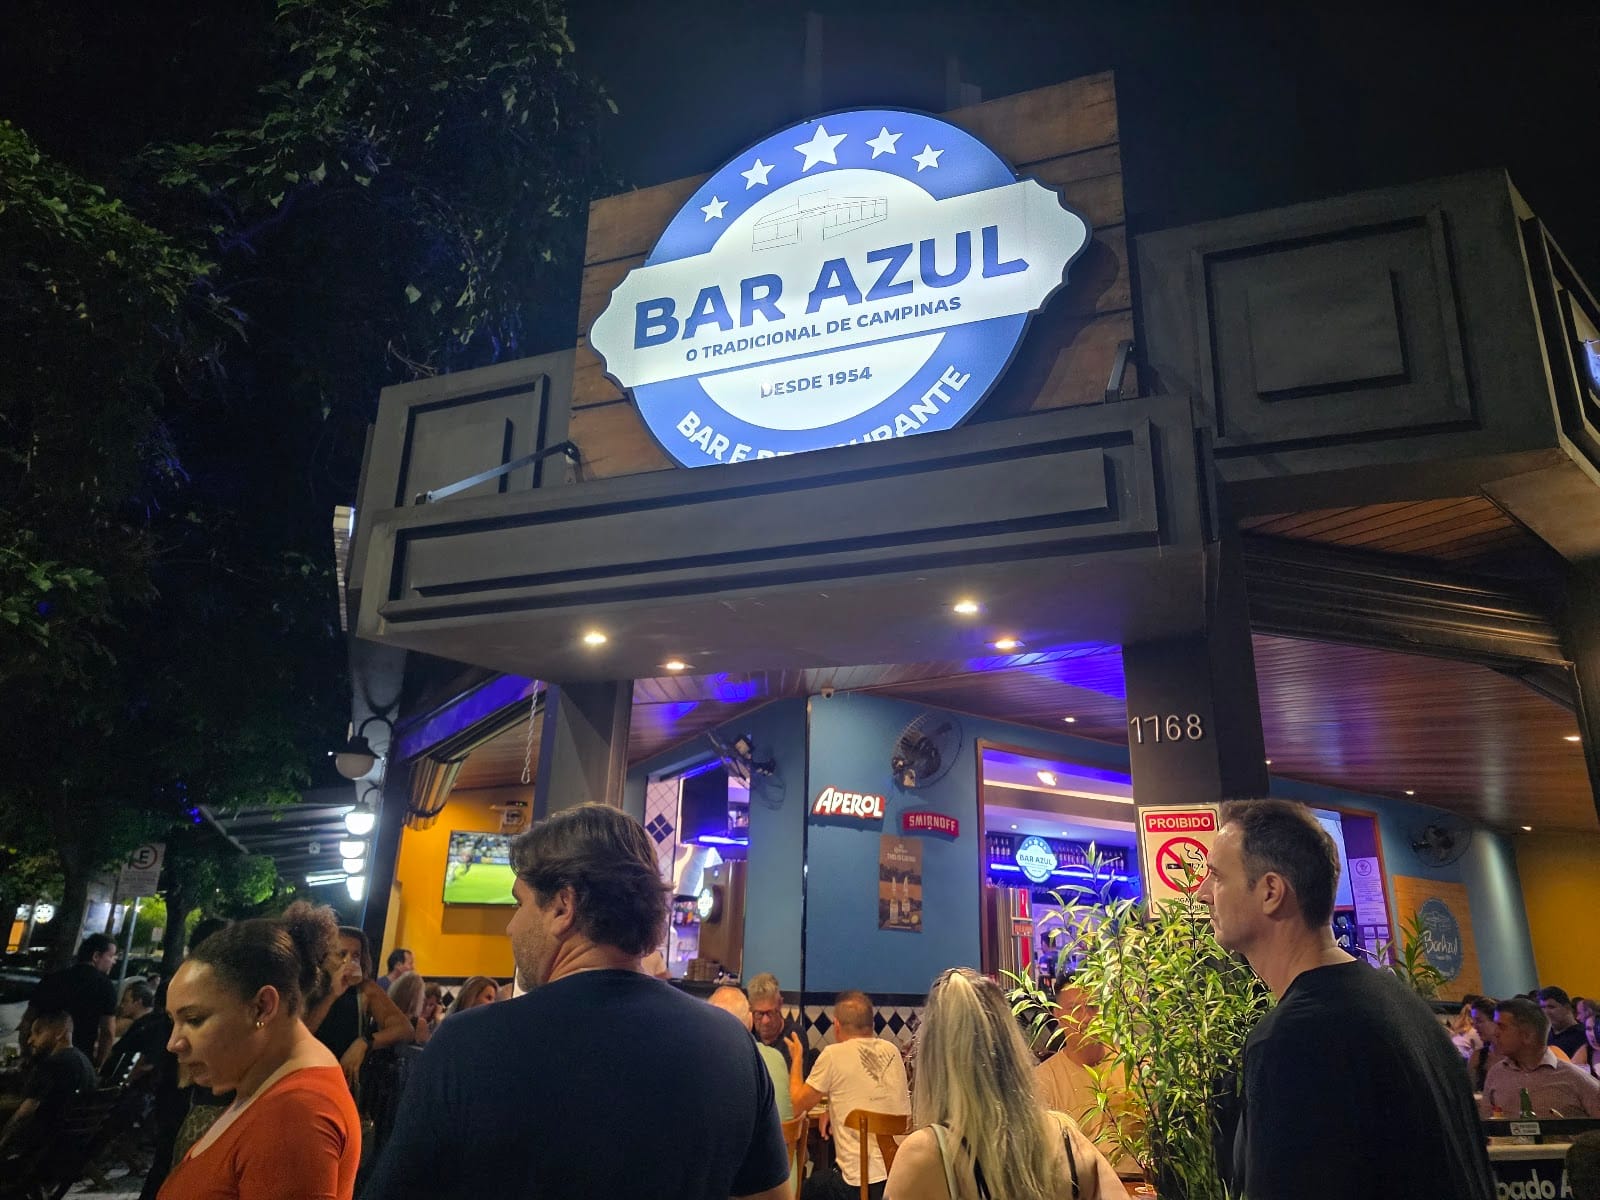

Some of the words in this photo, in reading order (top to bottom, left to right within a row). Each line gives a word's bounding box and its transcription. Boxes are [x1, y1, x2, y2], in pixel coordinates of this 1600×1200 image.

[634, 273, 786, 349] BAR
[805, 225, 1029, 314] AZUL
[686, 349, 697, 361] O
[702, 325, 821, 358] TRADICIONAL
[826, 318, 851, 335] DE
[856, 296, 962, 328] CAMPINAS
[760, 375, 823, 398] DESDE
[827, 367, 873, 387] 1954
[676, 410, 730, 461] BAR
[1130, 714, 1202, 743] 1768
[815, 787, 883, 818] APEROL
[909, 815, 956, 832] SMIRNOFF
[1149, 816, 1211, 829] PROIBIDO
[1020, 854, 1034, 863] BAR
[1035, 857, 1053, 866] AZUL
